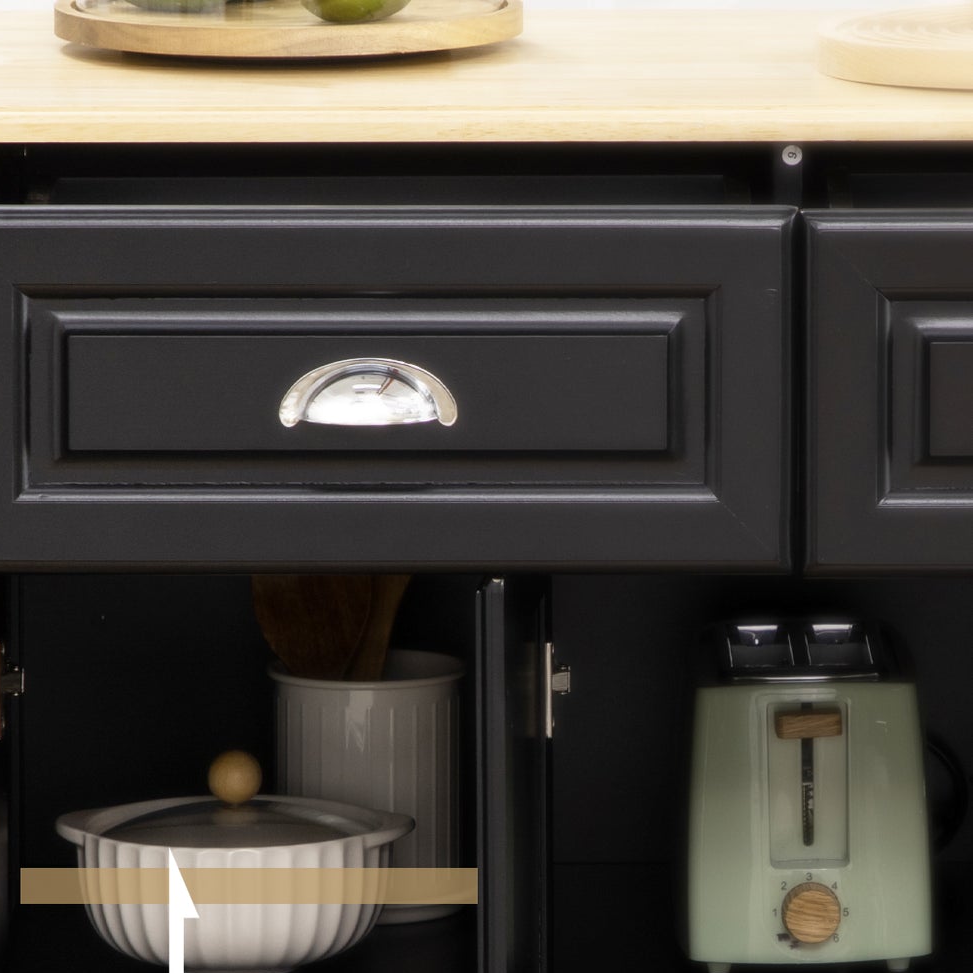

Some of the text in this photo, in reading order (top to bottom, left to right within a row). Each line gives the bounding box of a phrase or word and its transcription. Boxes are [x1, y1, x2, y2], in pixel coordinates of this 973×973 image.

[806, 872, 813, 881] 3
[780, 881, 787, 890] 2
[831, 881, 838, 890] 4
[772, 908, 778, 917] 1
[842, 907, 850, 917] 5
[833, 933, 840, 943] 6
